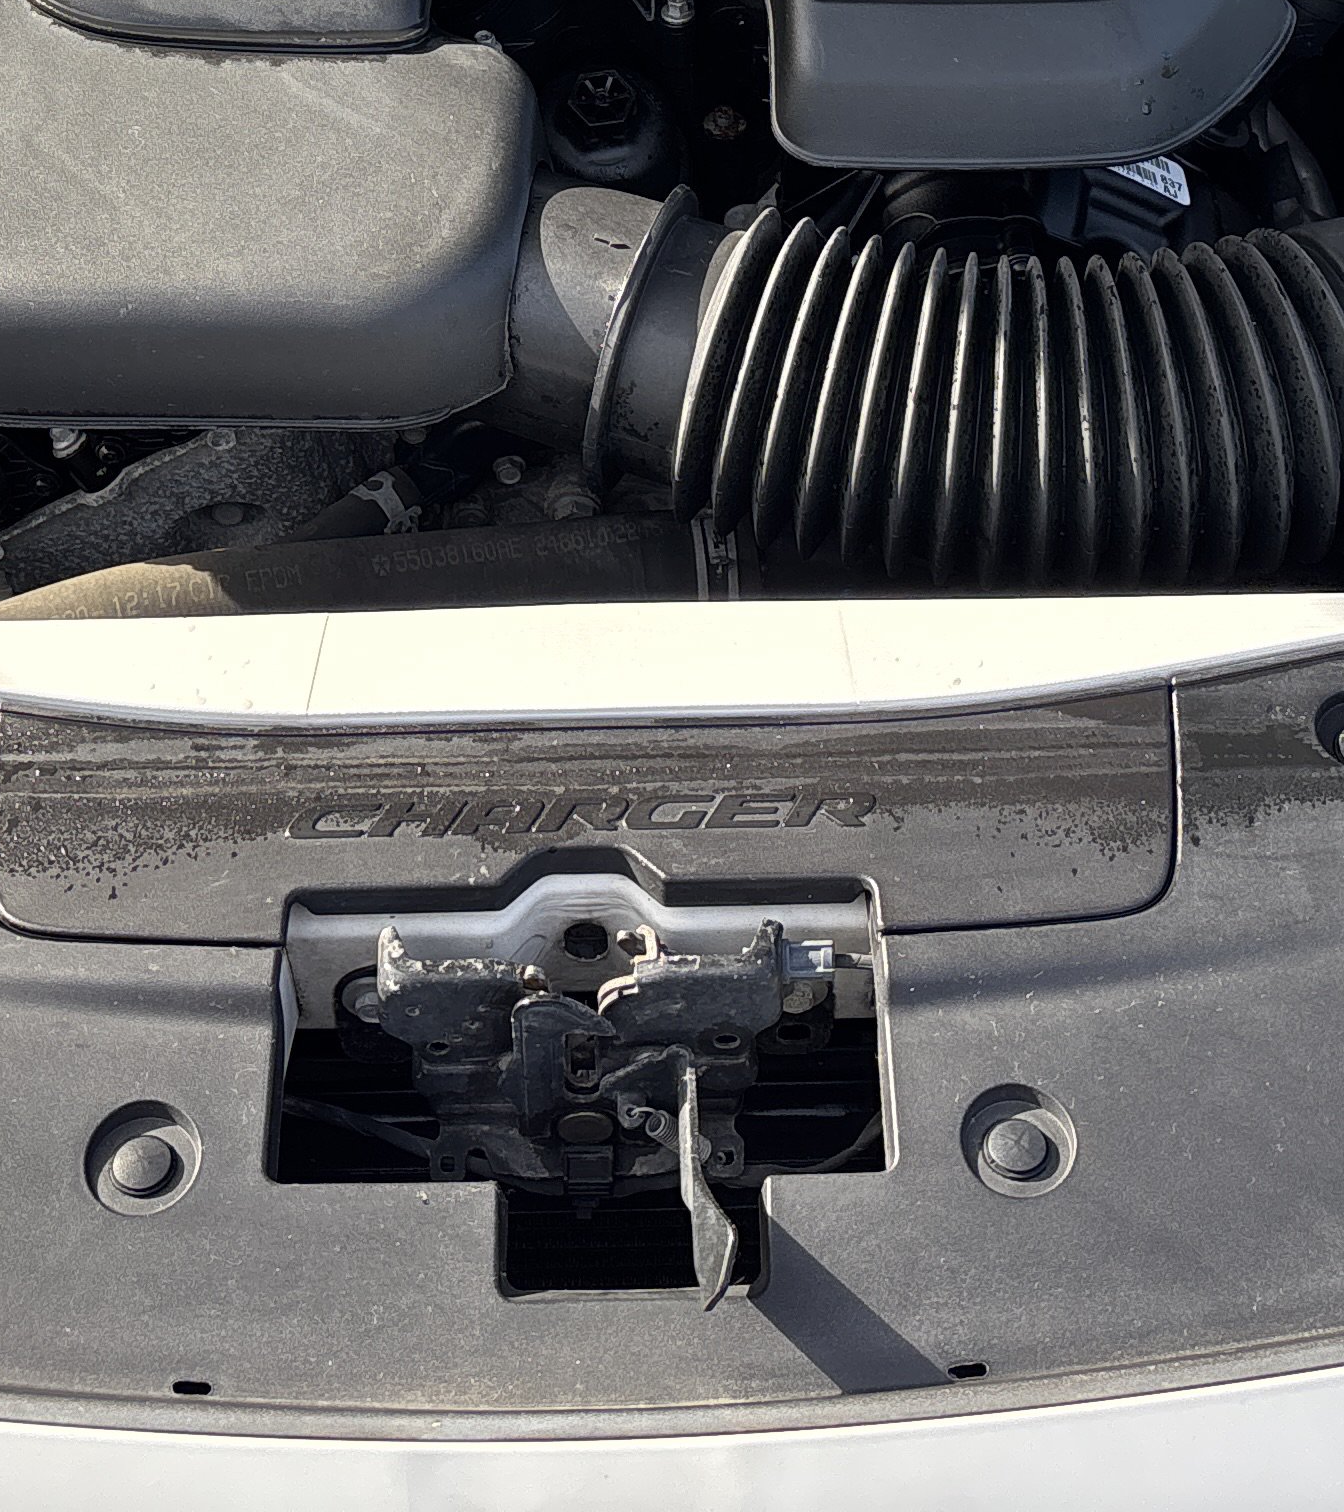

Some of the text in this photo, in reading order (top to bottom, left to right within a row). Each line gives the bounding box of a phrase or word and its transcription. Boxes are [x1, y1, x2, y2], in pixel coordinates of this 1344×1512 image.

[1159, 173, 1183, 192] 837
[1163, 183, 1179, 199] AJ
[244, 563, 305, 593] EPDM
[285, 792, 878, 839] CHARGER
